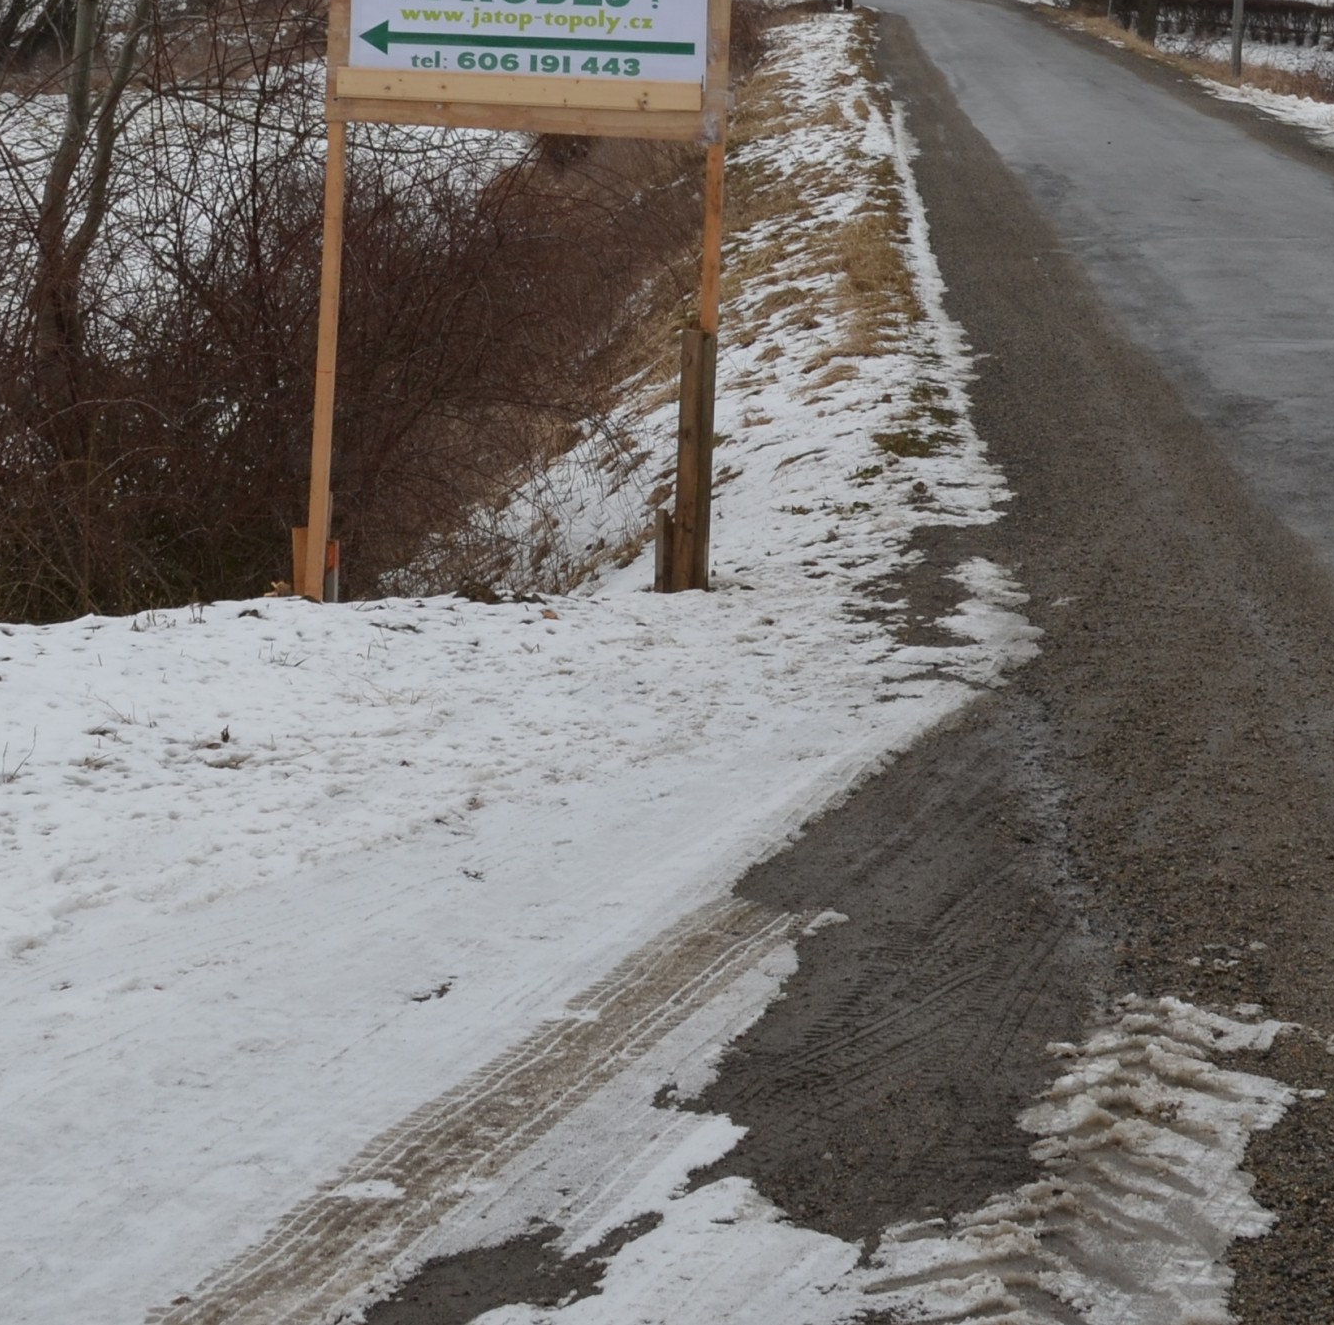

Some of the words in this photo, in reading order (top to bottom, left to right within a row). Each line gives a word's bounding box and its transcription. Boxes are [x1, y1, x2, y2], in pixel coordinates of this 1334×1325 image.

[401, 7, 653, 34] www.jatop-topoly.cz
[411, 51, 448, 69] tel:
[457, 51, 520, 72] 606
[529, 54, 571, 74] 191
[581, 56, 641, 77] 443
